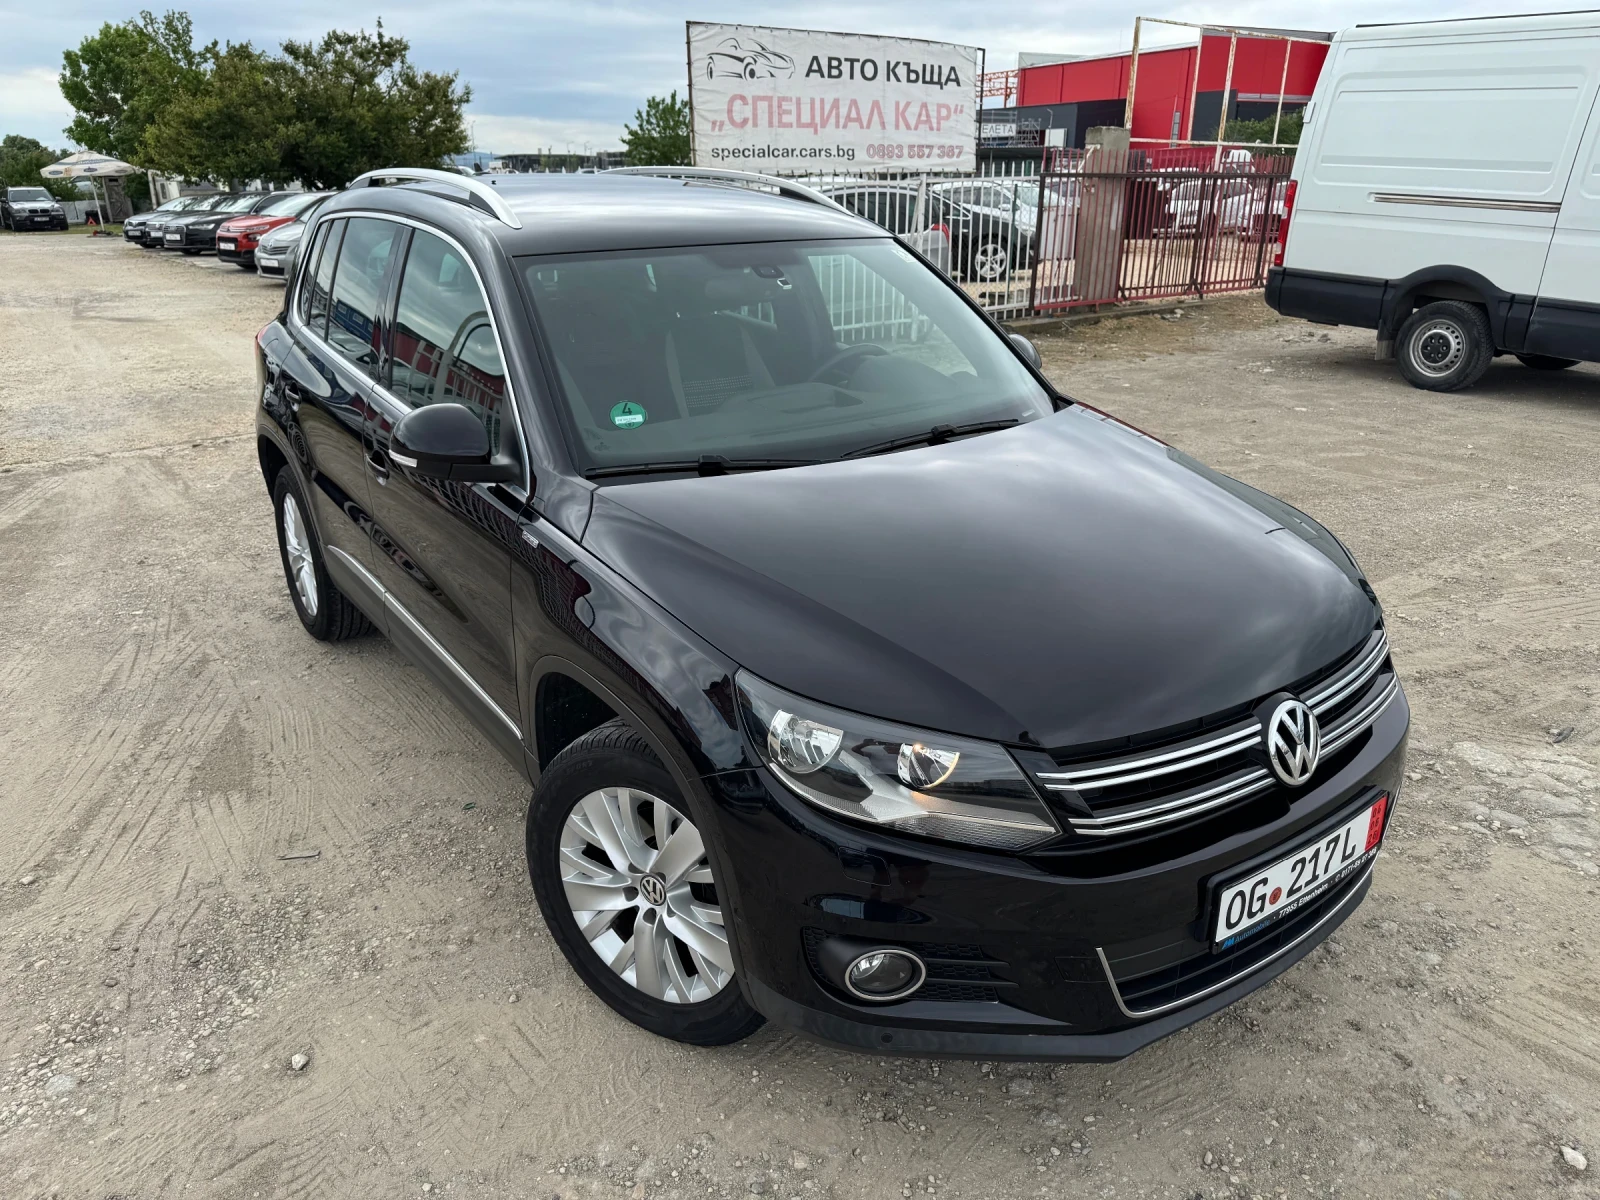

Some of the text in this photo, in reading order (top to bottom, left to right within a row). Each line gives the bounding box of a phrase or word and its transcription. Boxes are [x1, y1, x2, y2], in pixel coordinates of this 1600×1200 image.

[805, 55, 962, 90] АВТО КЪЩА
[711, 144, 855, 161] specialcar.cars.bg
[622, 402, 632, 415] 4
[1225, 826, 1356, 930] OG 217L
